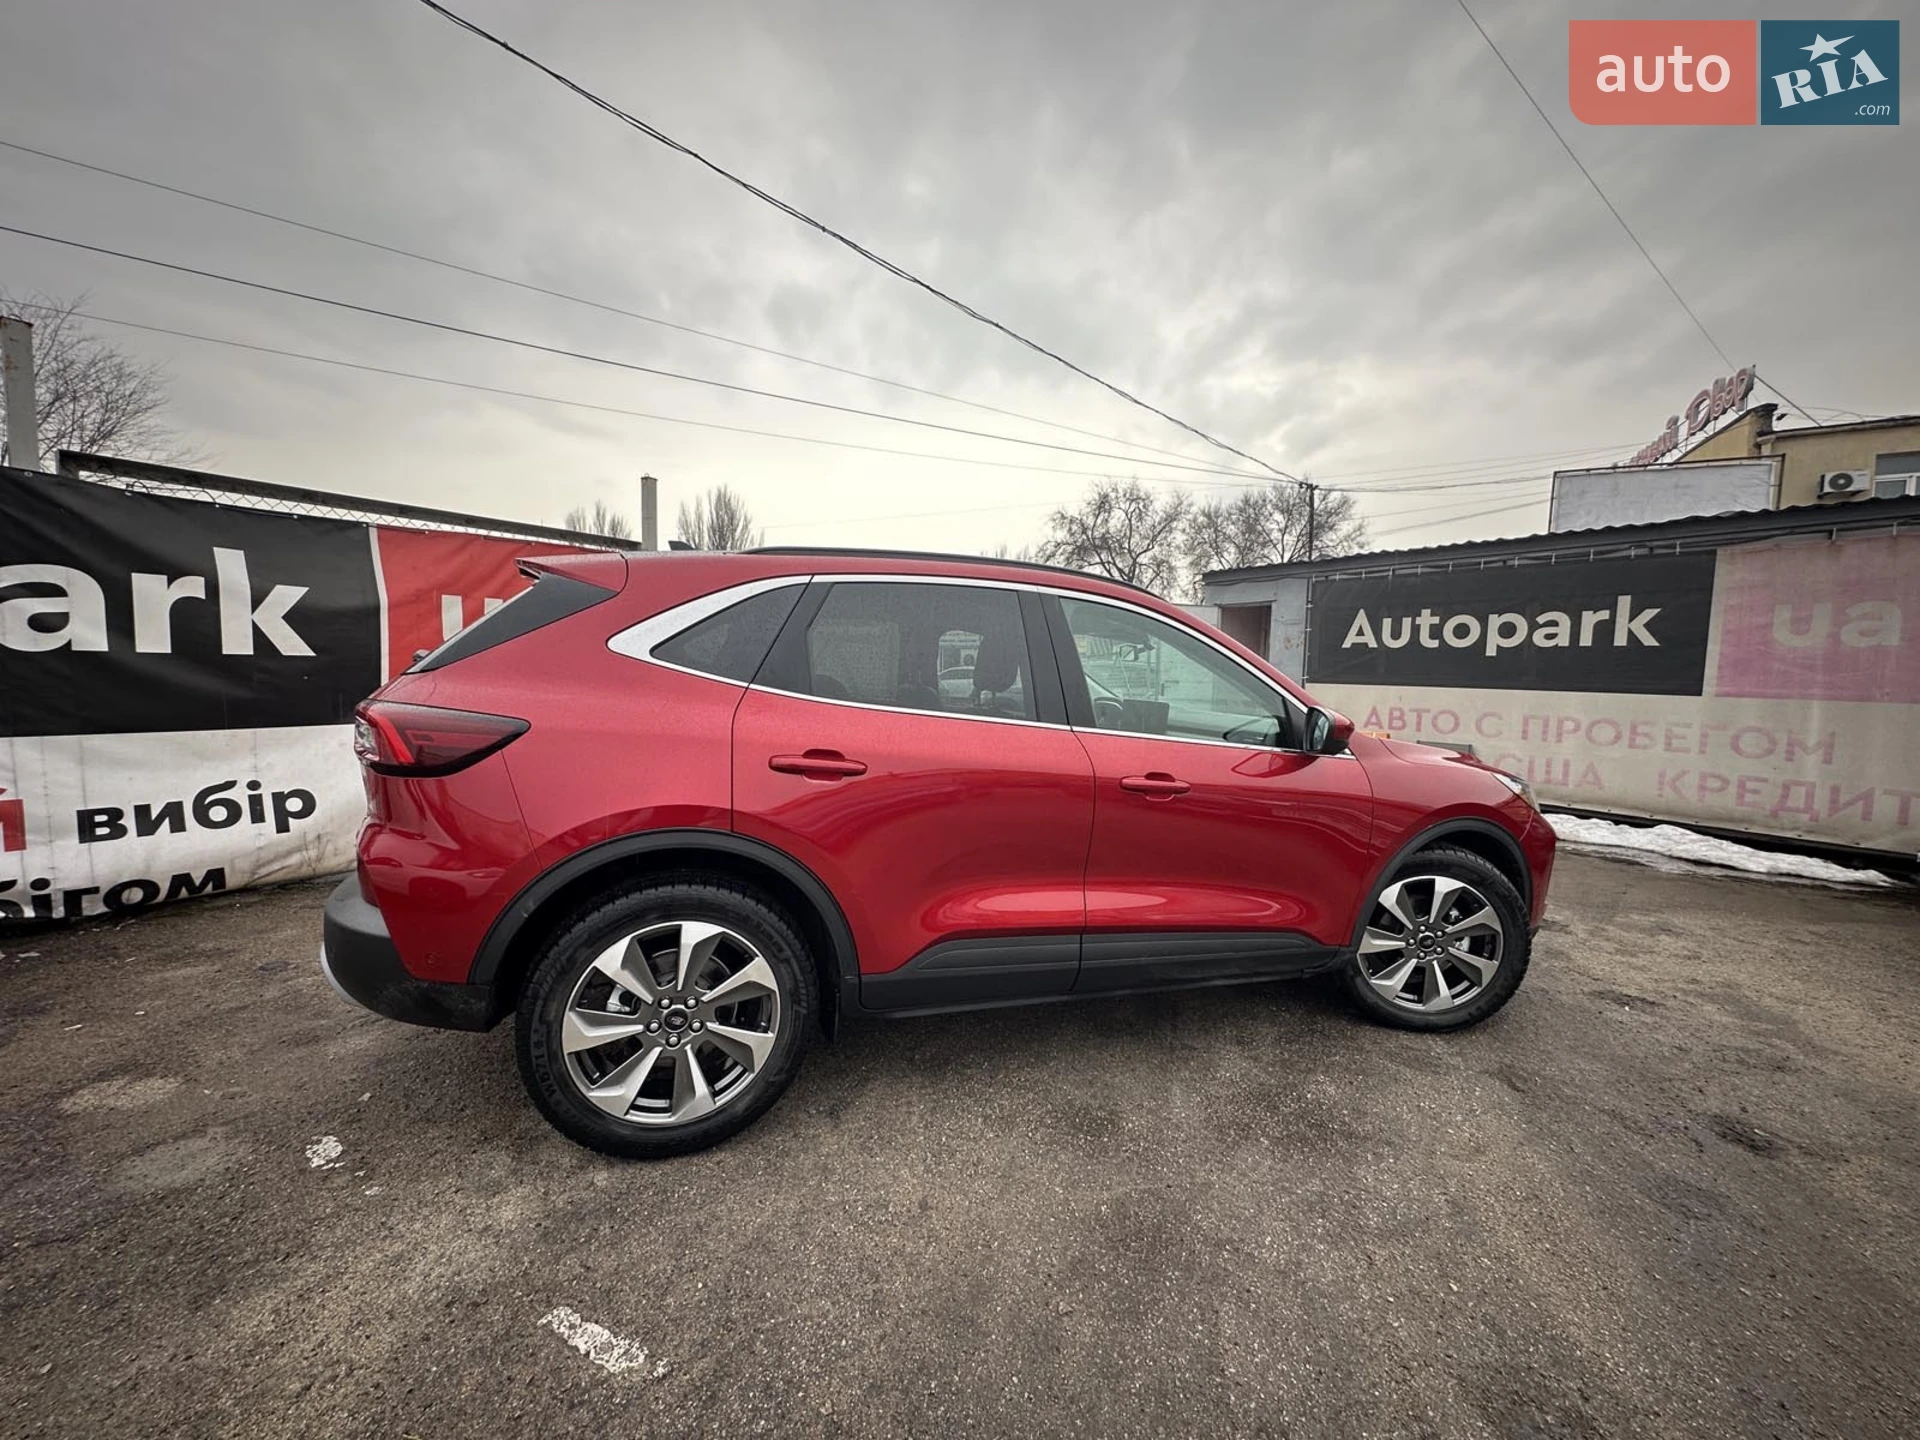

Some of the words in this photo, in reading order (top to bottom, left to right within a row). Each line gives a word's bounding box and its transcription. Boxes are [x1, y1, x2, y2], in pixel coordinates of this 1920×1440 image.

[1341, 594, 1662, 657] Autopark
[1772, 600, 1902, 648] ua
[1363, 704, 1461, 735] АВТО
[1475, 709, 1503, 739] С
[1521, 713, 1837, 766] ПРОБЕГОМ
[76, 778, 318, 845] вибір
[1656, 767, 1920, 827] КРЕДИТ
